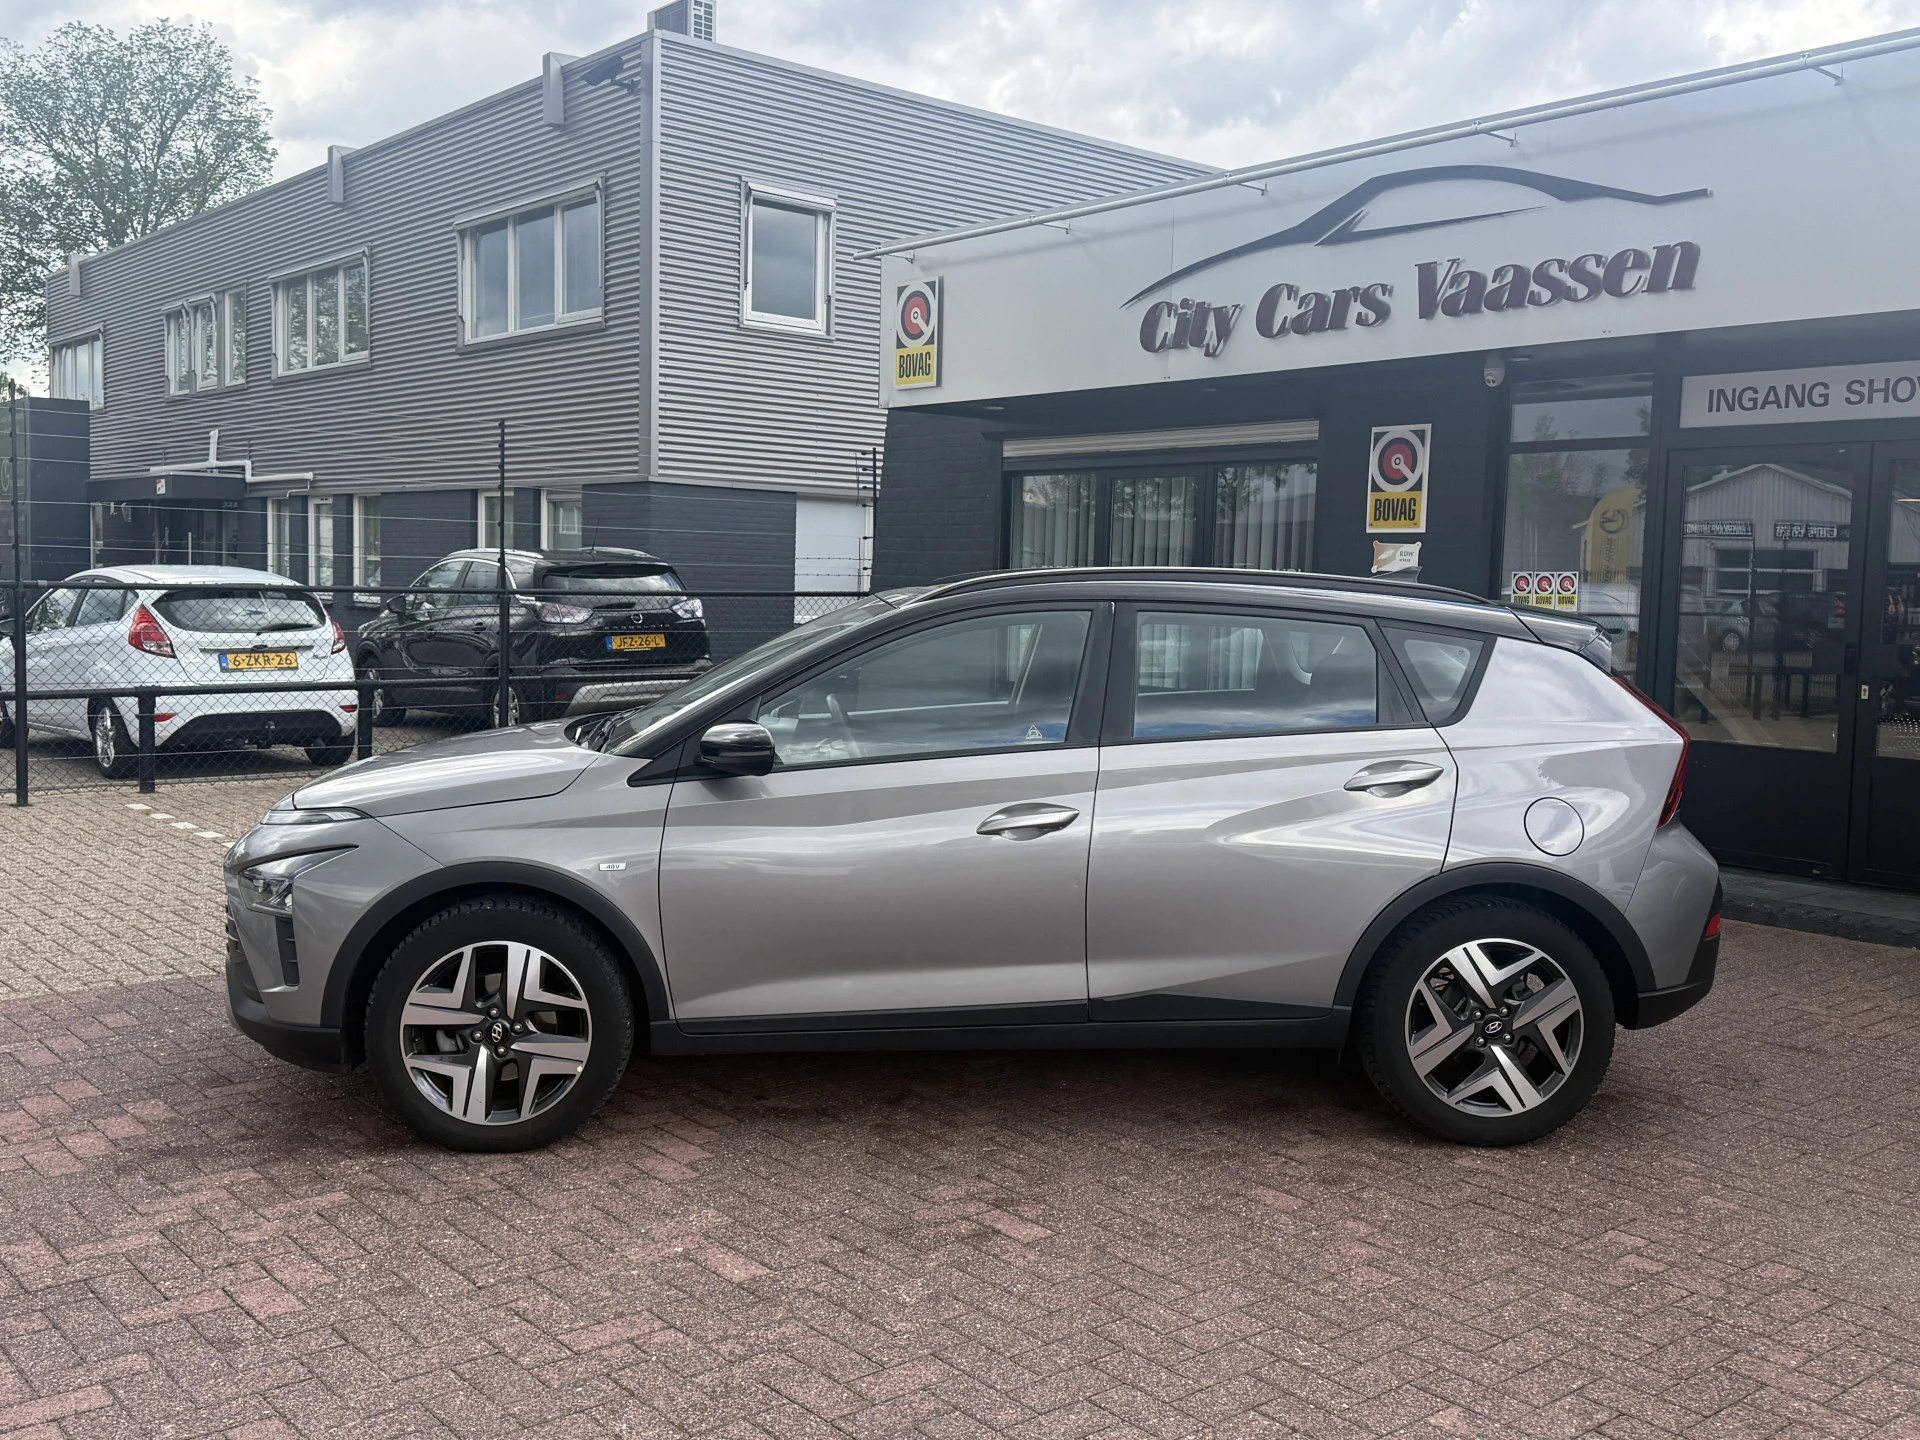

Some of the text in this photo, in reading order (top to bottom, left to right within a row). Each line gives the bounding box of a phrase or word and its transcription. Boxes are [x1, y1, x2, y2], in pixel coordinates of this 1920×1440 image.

[1140, 241, 1699, 357] City Cars Vaassen
[898, 351, 931, 378] BOVAG
[1707, 375, 1920, 413] INGANG SHO
[1373, 497, 1417, 522] BOVAG
[1535, 596, 1552, 605] BOVAG
[1557, 596, 1575, 605] BOVAG
[617, 635, 661, 648] JFZ-26-L
[232, 654, 293, 667] 6-ZKR-26
